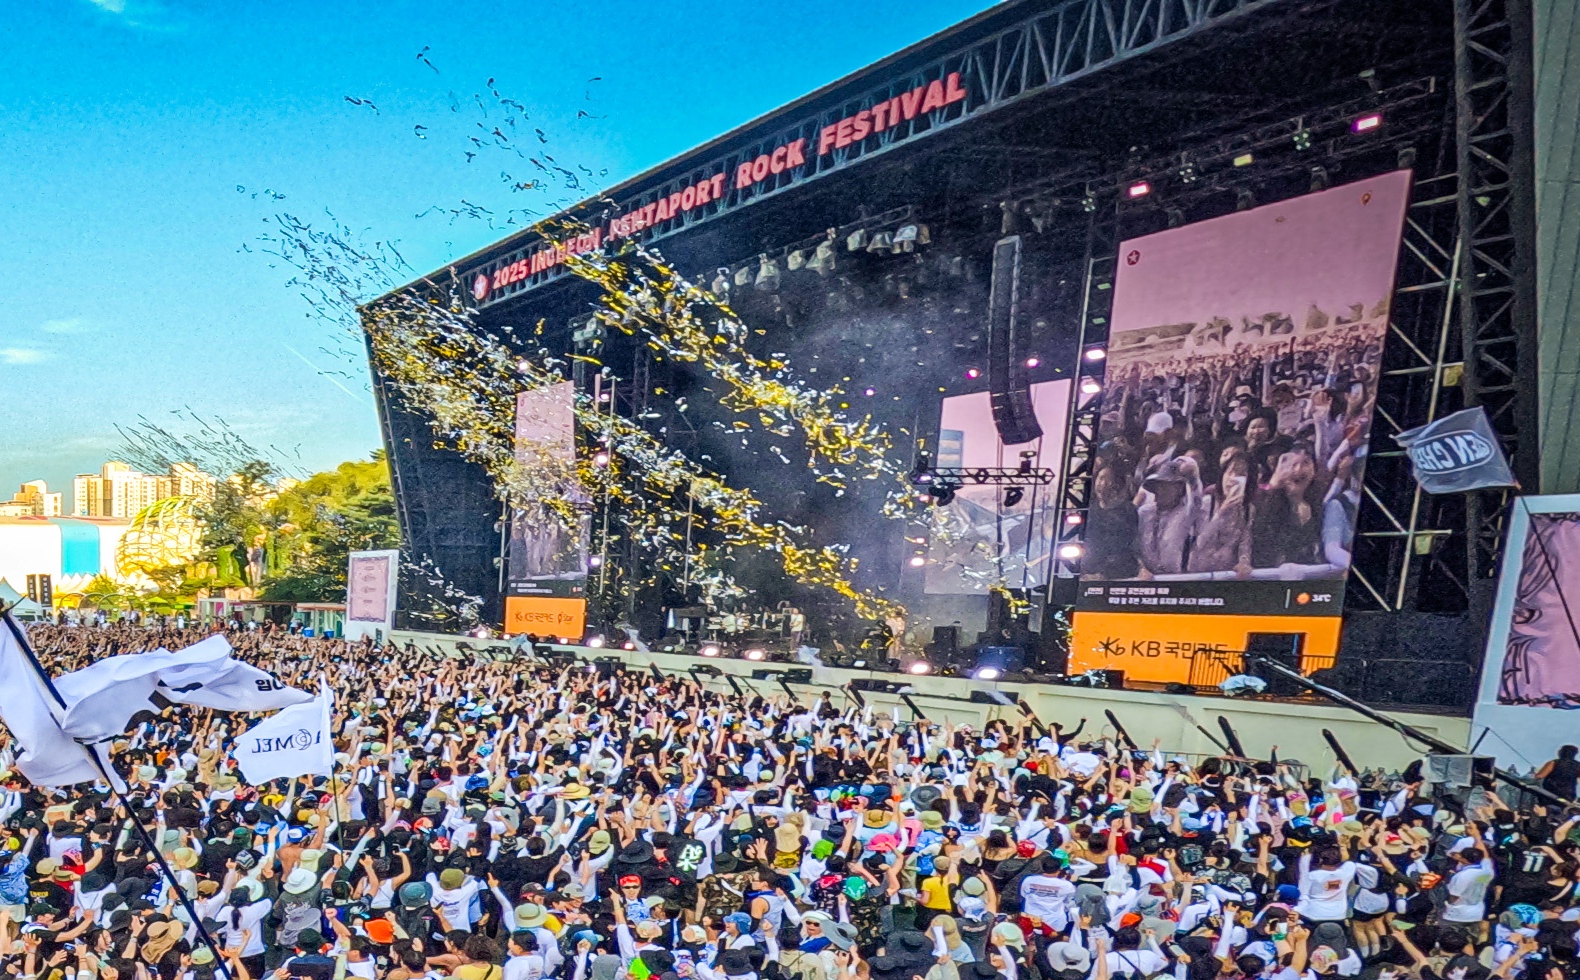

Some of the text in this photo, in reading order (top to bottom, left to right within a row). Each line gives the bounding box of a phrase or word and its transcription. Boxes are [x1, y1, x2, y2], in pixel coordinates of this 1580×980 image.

[493, 259, 529, 290] 2025
[610, 173, 726, 241] PENTAPORT
[736, 137, 804, 188] ROCK
[818, 72, 966, 156] FESTIVAL
